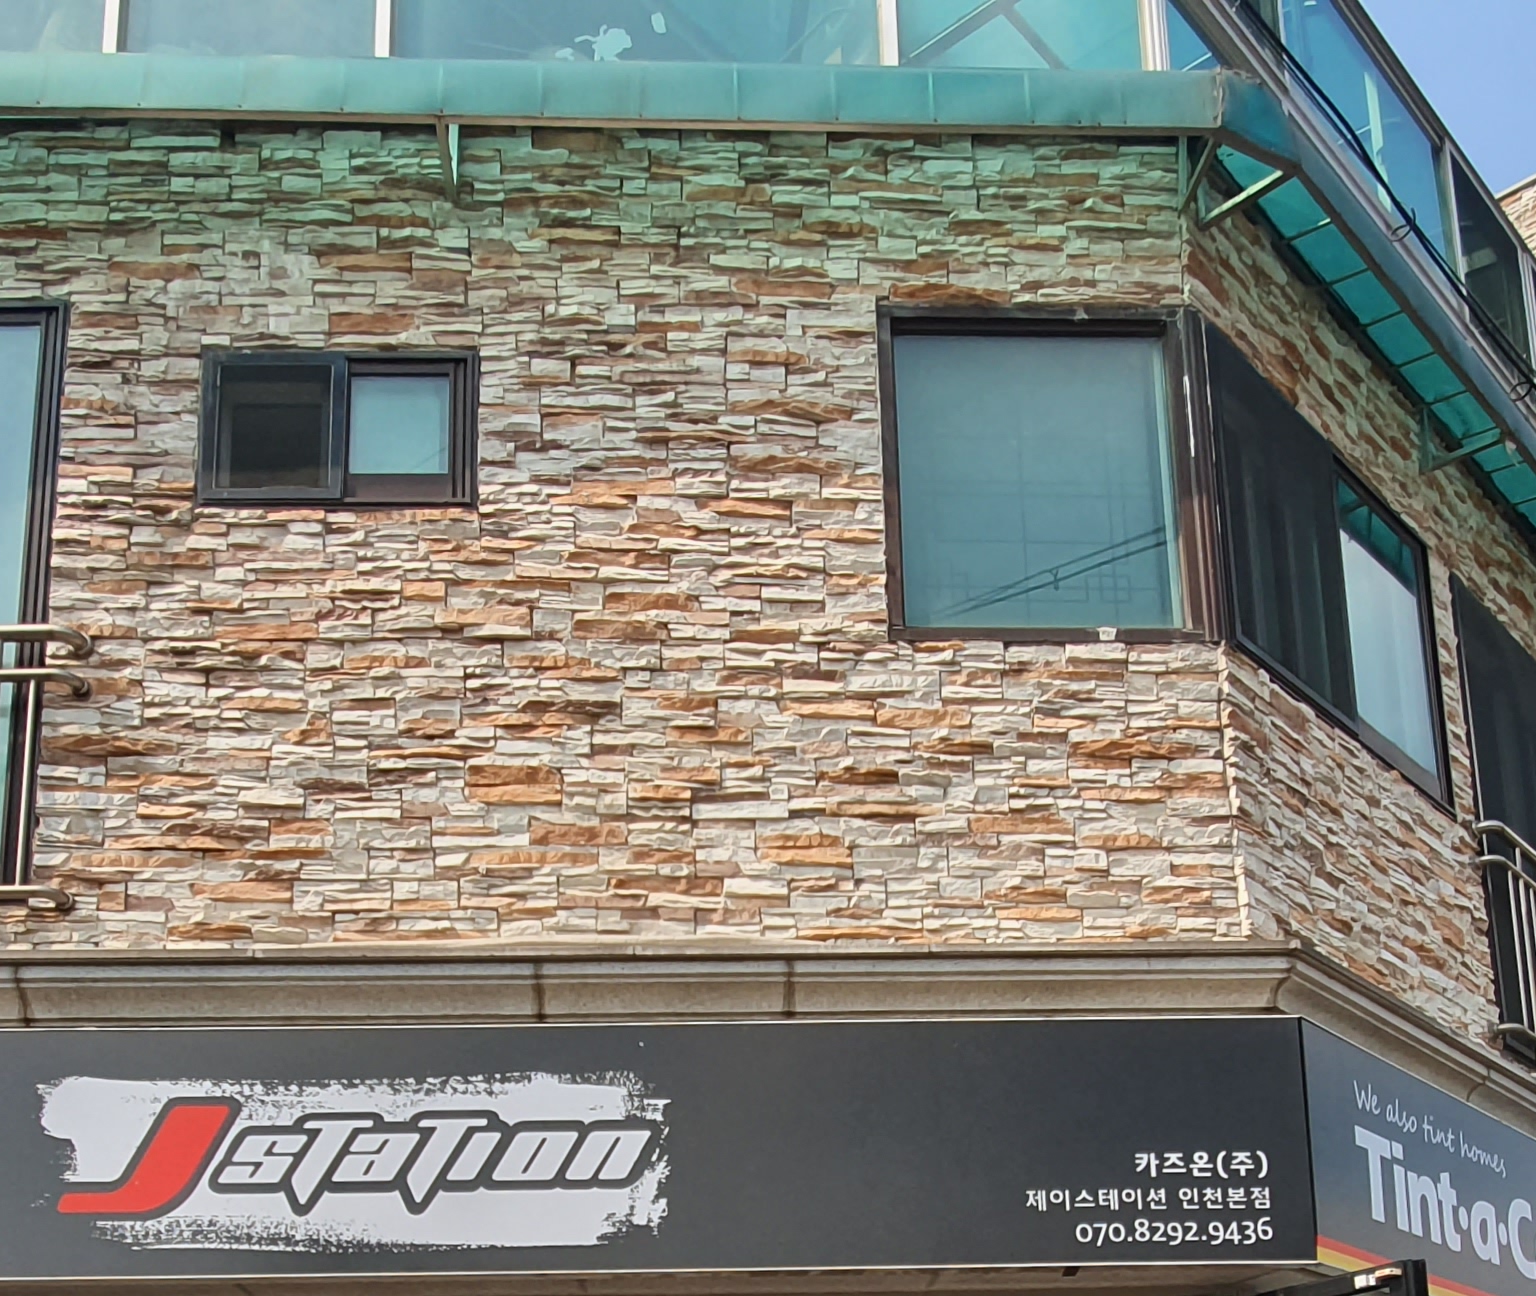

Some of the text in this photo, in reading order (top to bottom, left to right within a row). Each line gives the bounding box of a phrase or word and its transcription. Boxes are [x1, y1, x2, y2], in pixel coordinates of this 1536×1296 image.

[1353, 1080, 1506, 1178] We also tint homes
[1134, 1150, 1269, 1179] 카즈온(주)
[1025, 1186, 1271, 1212] 제이스테이션 인천본점
[1075, 1216, 1273, 1247] 070.8292.9436
